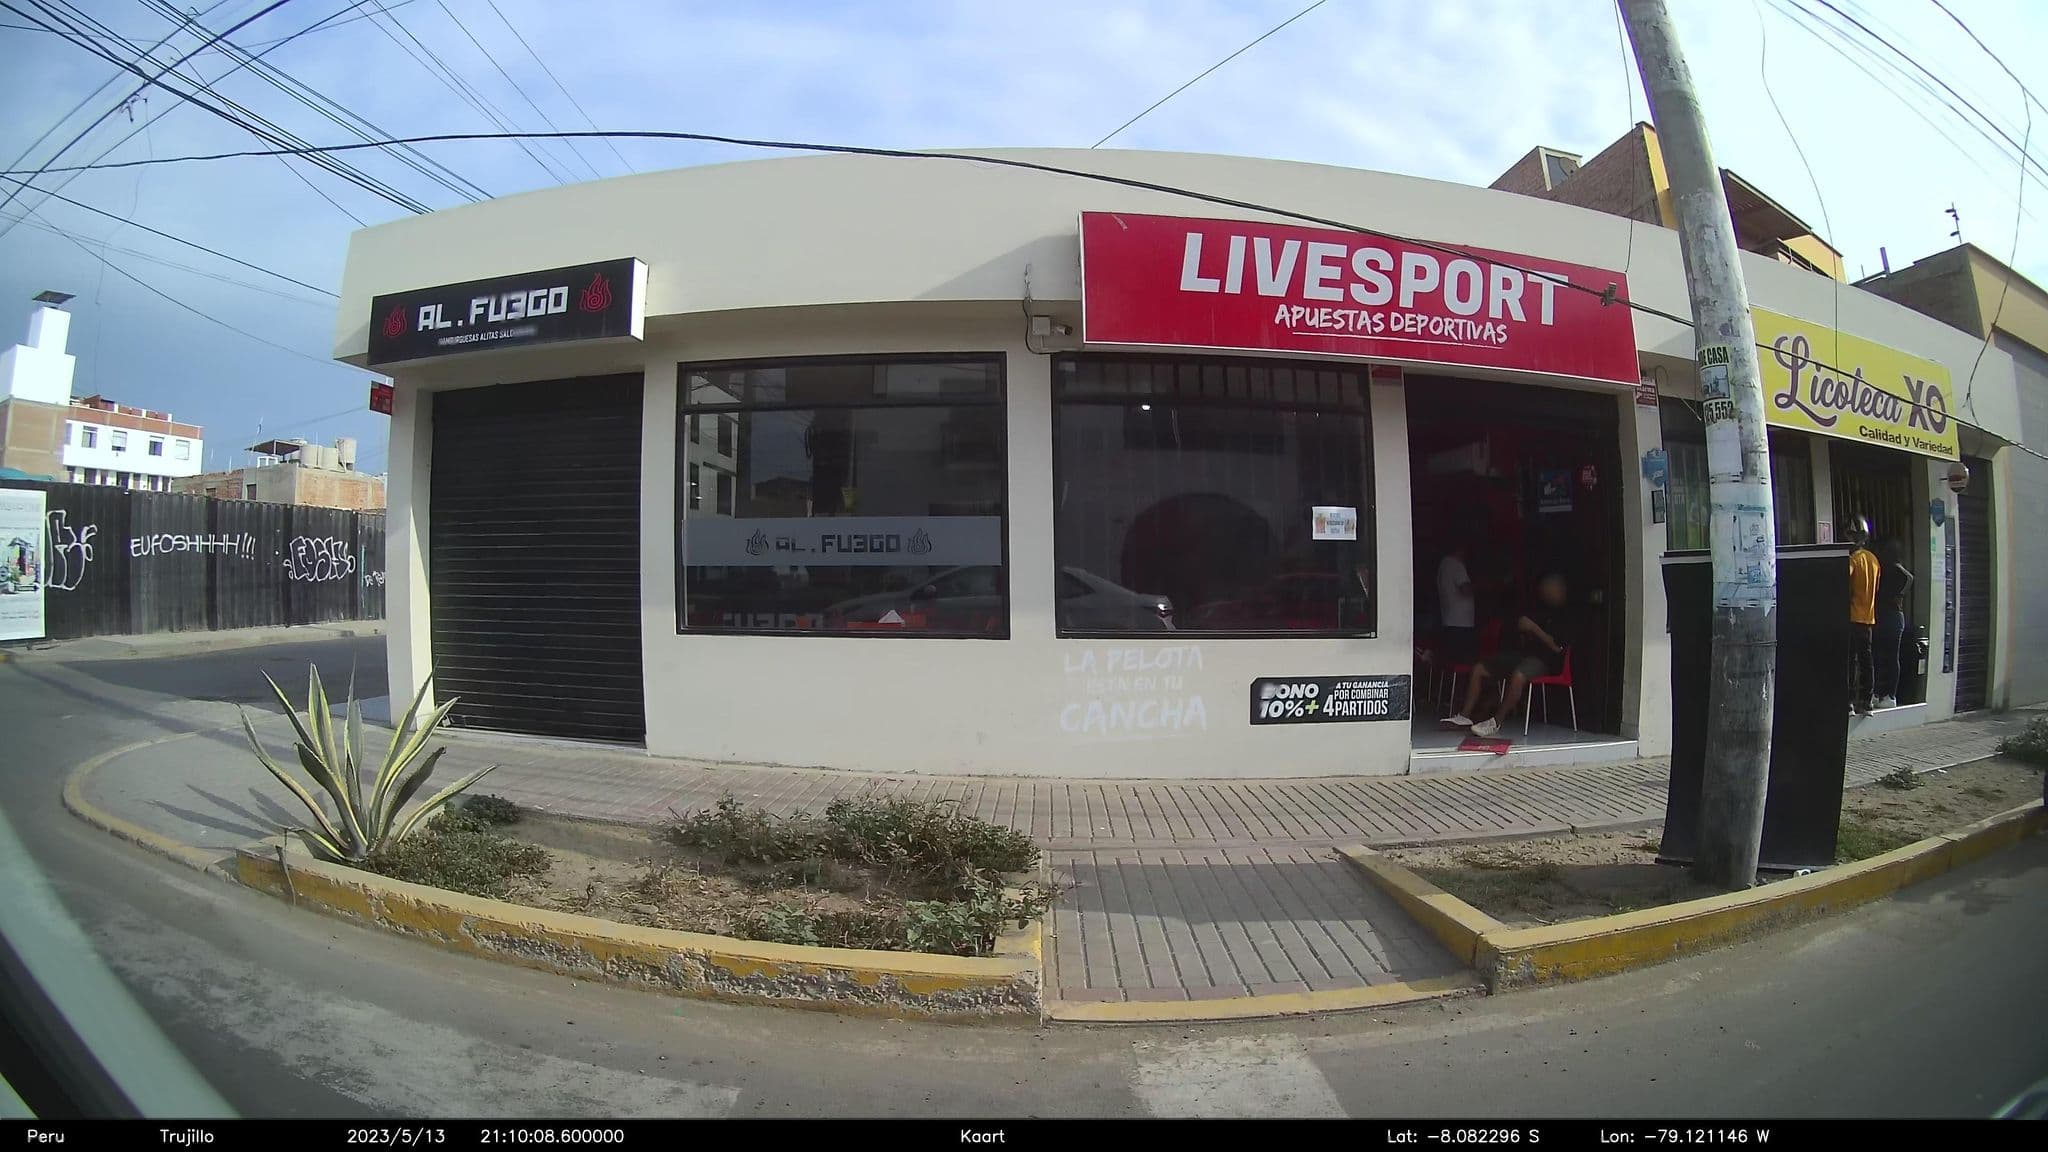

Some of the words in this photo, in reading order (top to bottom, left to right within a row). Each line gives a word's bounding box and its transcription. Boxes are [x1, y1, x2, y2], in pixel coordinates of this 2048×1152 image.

[1179, 231, 1570, 326] LIVESPORT
[1275, 303, 1385, 335] APUESTAS
[1390, 312, 1509, 344] DEPORTIVAS
[480, 330, 499, 341] ALITAS
[1707, 346, 1730, 365] CASA
[1773, 335, 1902, 427] Licoteca
[1902, 375, 1948, 434] XO
[1859, 425, 1902, 445] Calidad
[1904, 436, 1911, 447] y
[1912, 437, 1953, 456] Variedad
[1064, 649, 1097, 675] LA
[1107, 645, 1204, 673] PELOTA
[1163, 675, 1183, 692] TU
[1260, 682, 1320, 700] BONO
[1352, 681, 1389, 689] GANANCIA
[1334, 689, 1350, 700] POR
[1351, 688, 1389, 700] COMBINAR
[1060, 694, 1208, 735] CANCHA
[1335, 699, 1388, 717] PARTIDOS
